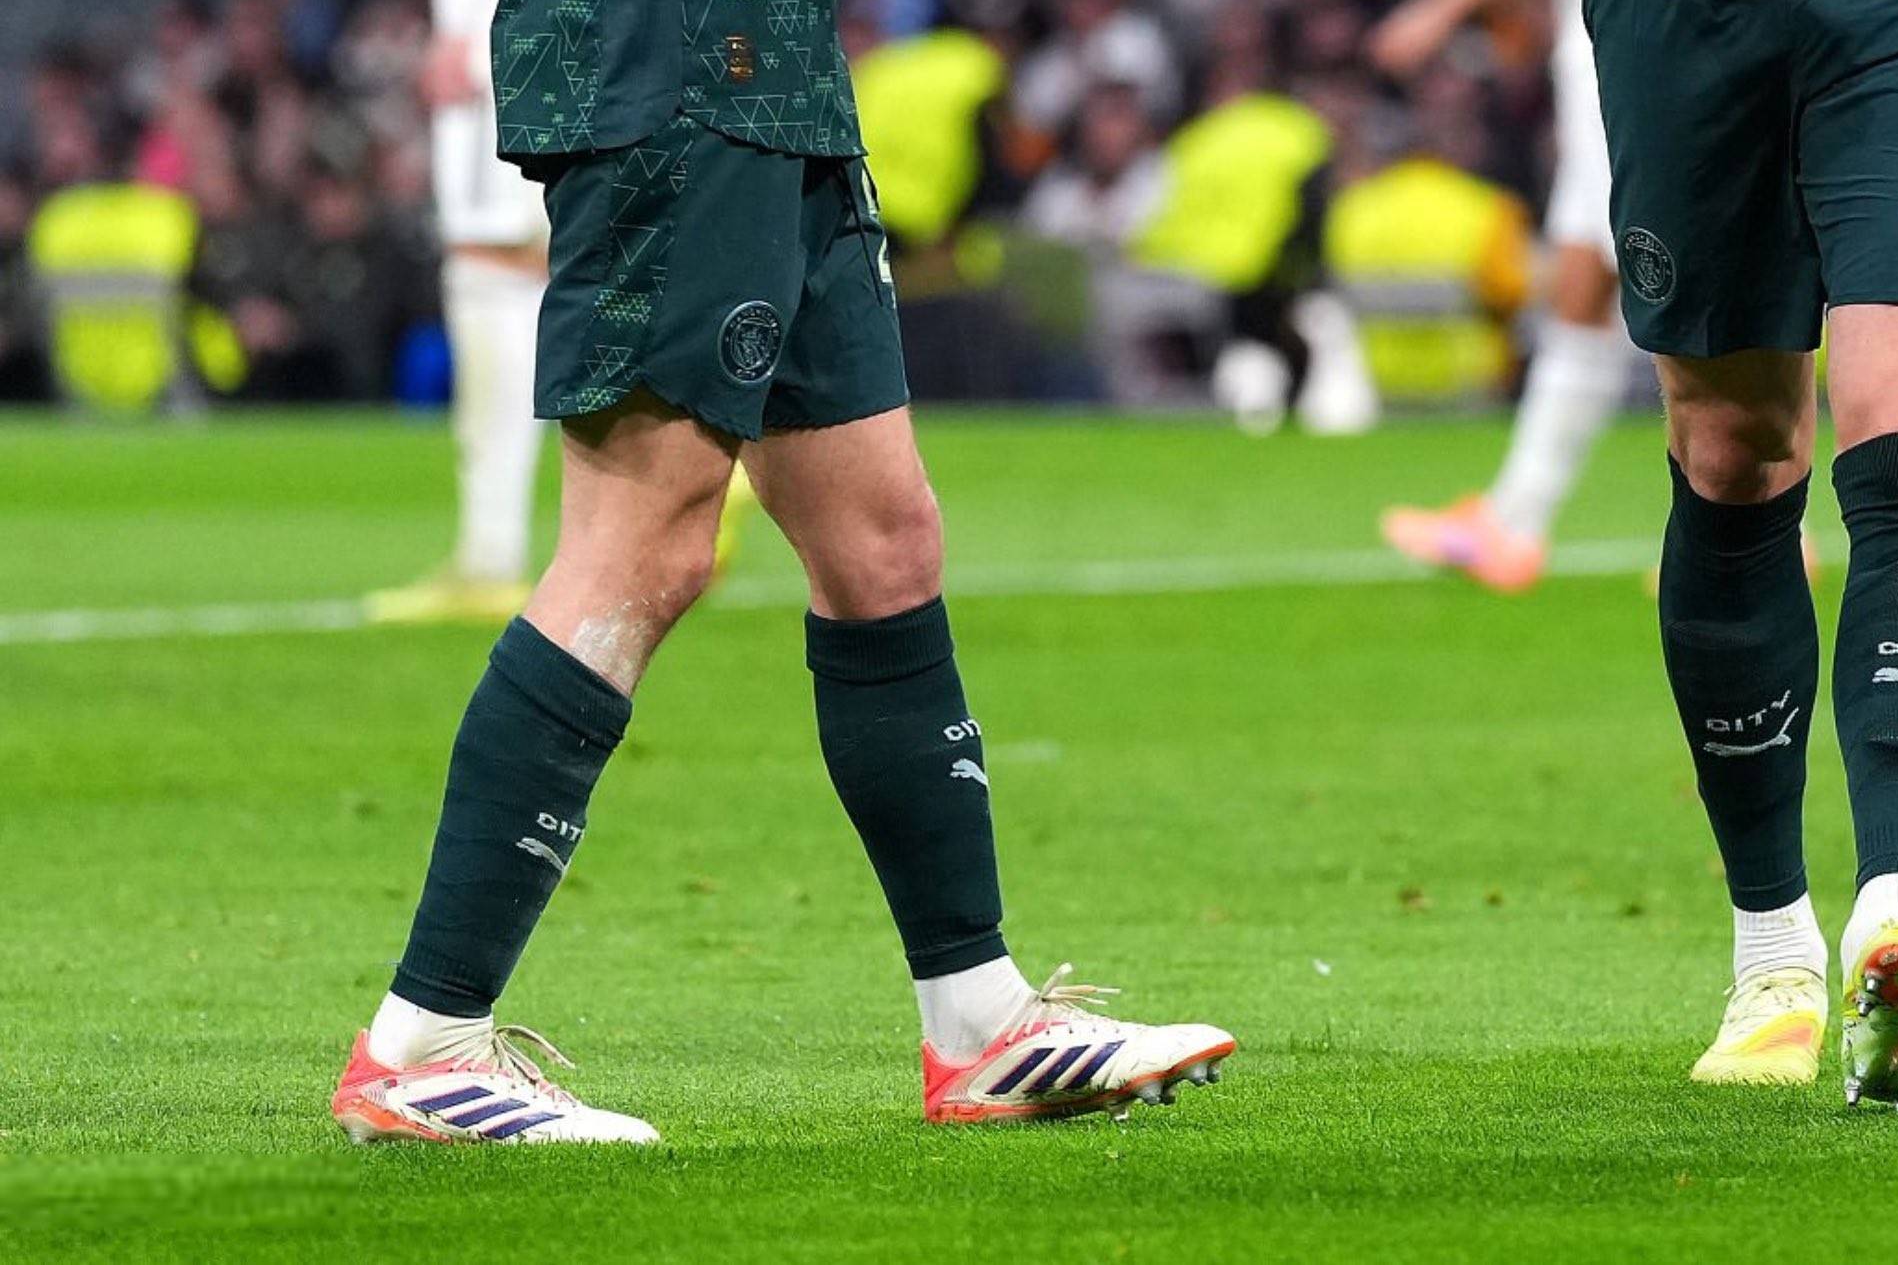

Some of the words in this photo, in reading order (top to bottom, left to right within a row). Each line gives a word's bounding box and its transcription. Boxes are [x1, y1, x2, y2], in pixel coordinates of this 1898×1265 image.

[1705, 689, 1791, 732] CITY
[943, 718, 982, 741] CIT
[536, 811, 582, 842] CIT
